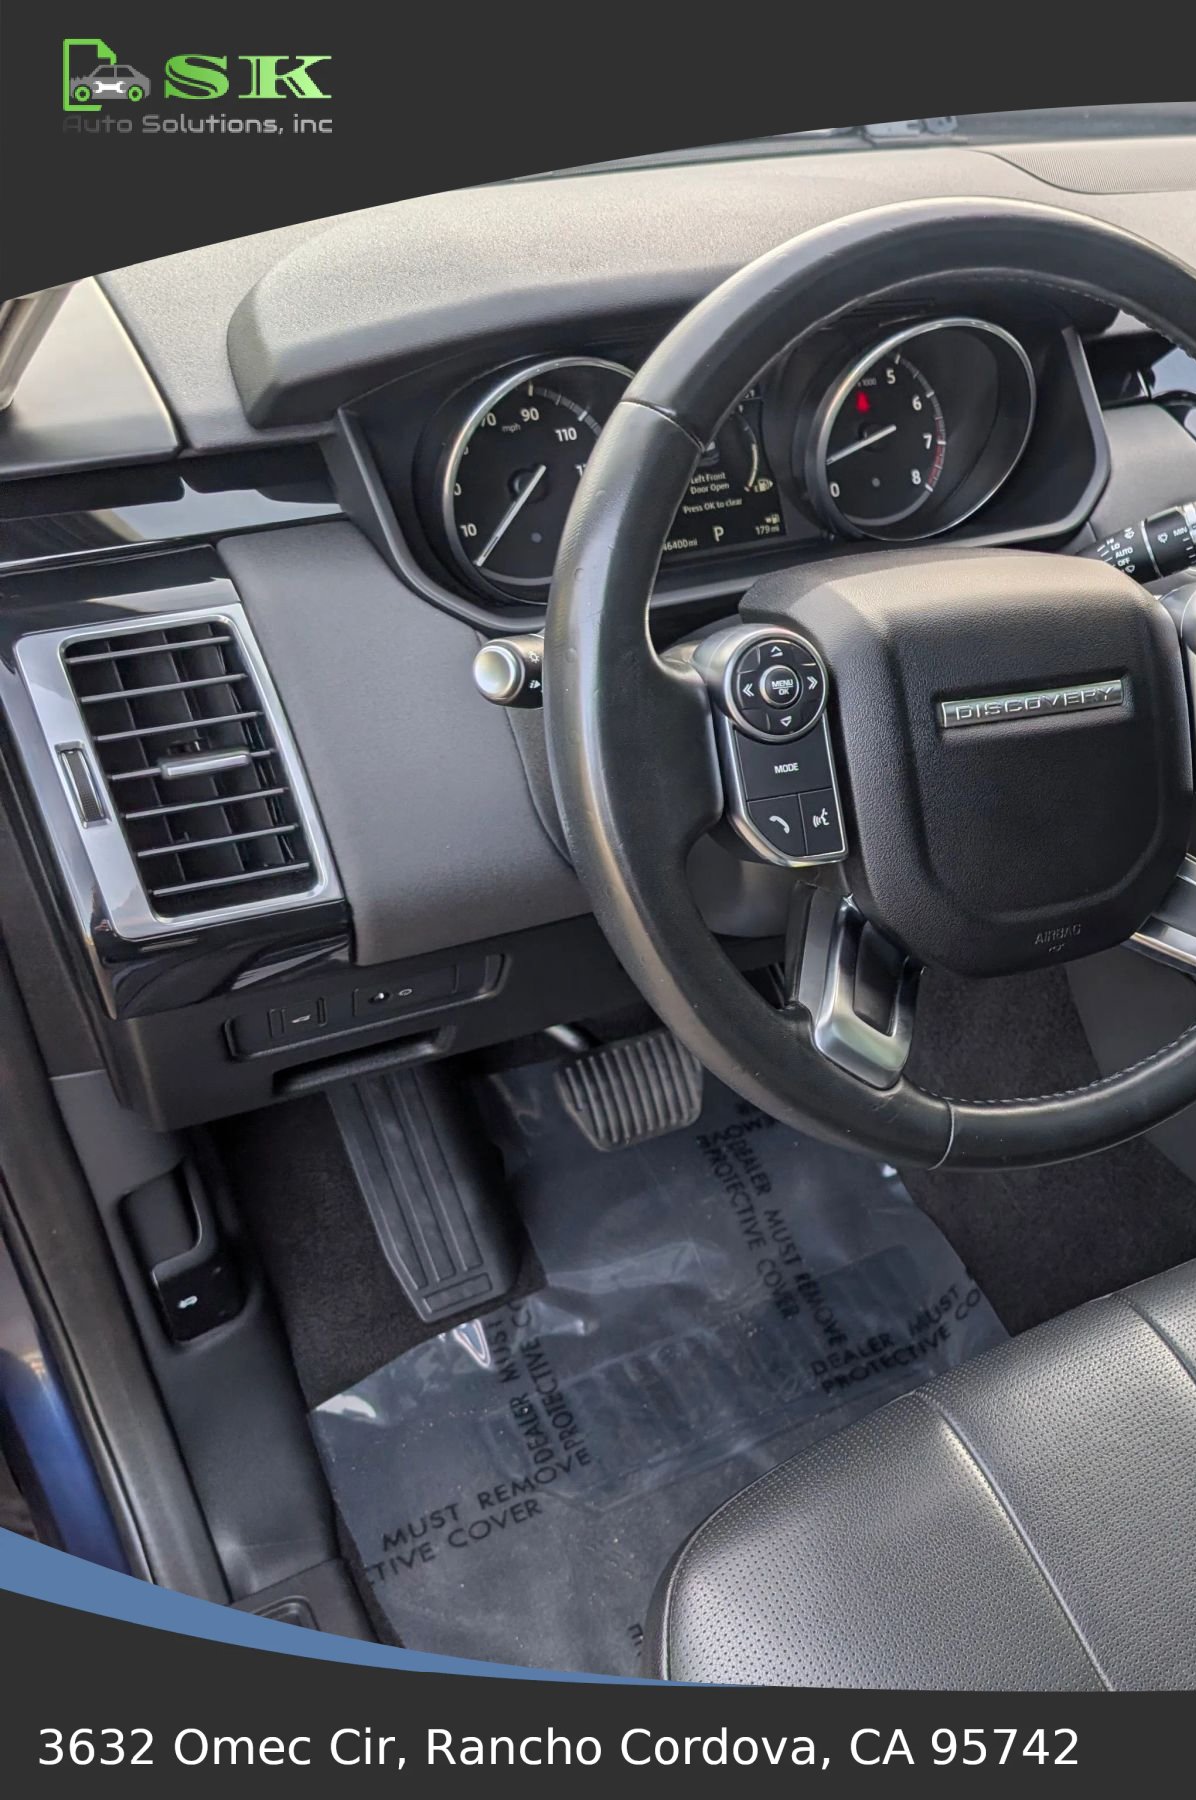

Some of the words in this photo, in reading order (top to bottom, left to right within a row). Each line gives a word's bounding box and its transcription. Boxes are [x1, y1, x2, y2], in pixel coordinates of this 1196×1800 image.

[886, 369, 896, 384] 5
[912, 396, 922, 411] 6
[520, 407, 540, 422] 90
[555, 427, 578, 442] 110
[923, 433, 932, 449] 7
[911, 469, 921, 485] 8
[830, 482, 840, 497] 0
[460, 523, 478, 538] 10
[712, 525, 725, 542] P
[1172, 526, 1188, 537] MIN
[1115, 546, 1134, 558] AUTO
[1117, 557, 1131, 567] OFF
[771, 678, 794, 689] MENU
[778, 687, 790, 696] OK
[955, 686, 1114, 721] DISCOVERY
[773, 762, 800, 774] MODE
[763, 1207, 804, 1266] MUST
[811, 1332, 895, 1377] DEALER
[908, 1284, 960, 1337] MUST
[821, 1324, 952, 1394] PROTECTIVE
[381, 1503, 460, 1552] MUST
[476, 1447, 592, 1511] REMOVE
[447, 1499, 542, 1548] COVER
